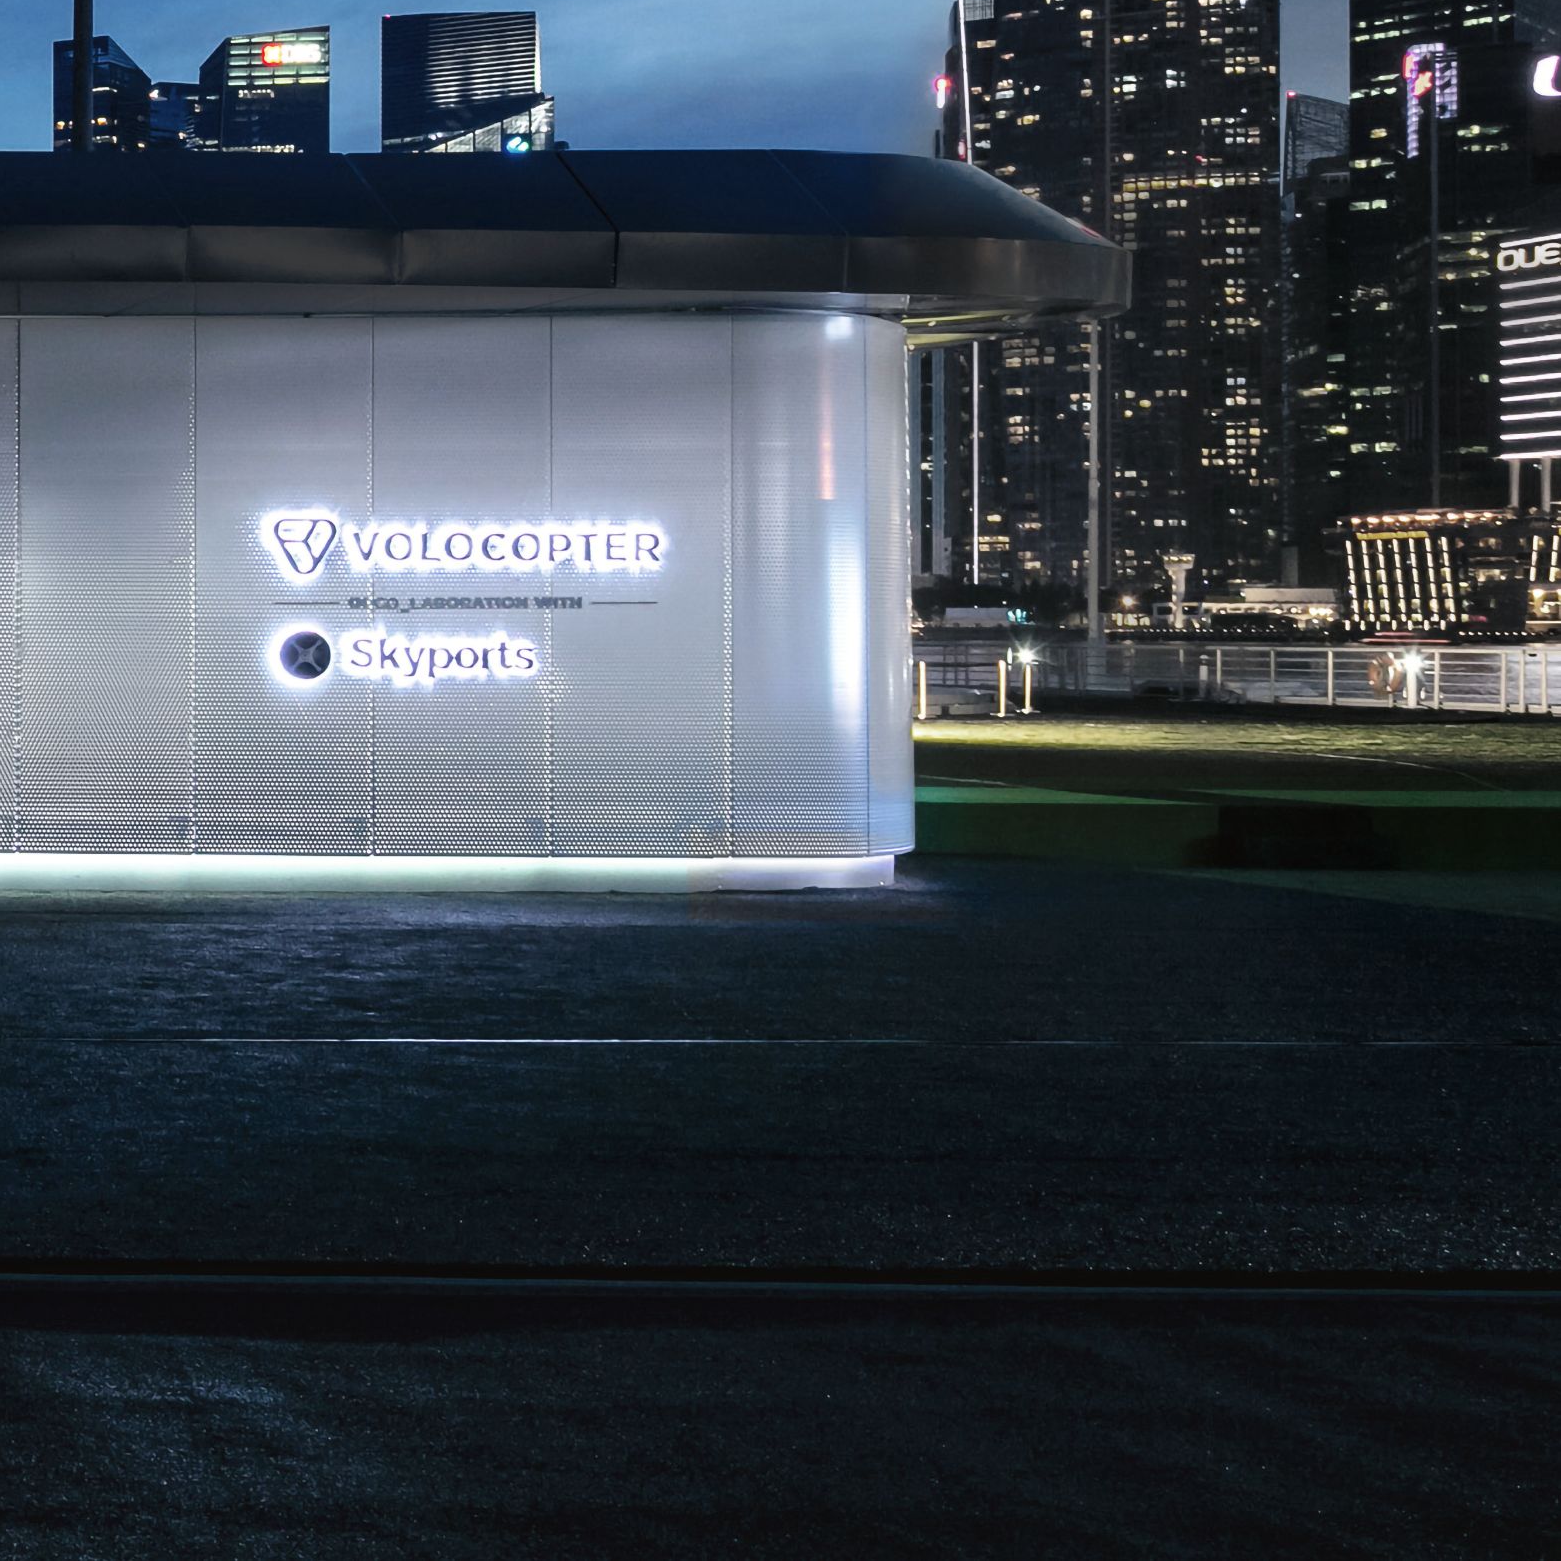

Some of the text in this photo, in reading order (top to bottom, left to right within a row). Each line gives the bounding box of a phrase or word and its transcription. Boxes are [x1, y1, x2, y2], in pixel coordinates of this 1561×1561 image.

[352, 532, 662, 562] VOLOCOPTER
[533, 596, 583, 609] WITH
[350, 638, 535, 678] Skyports
